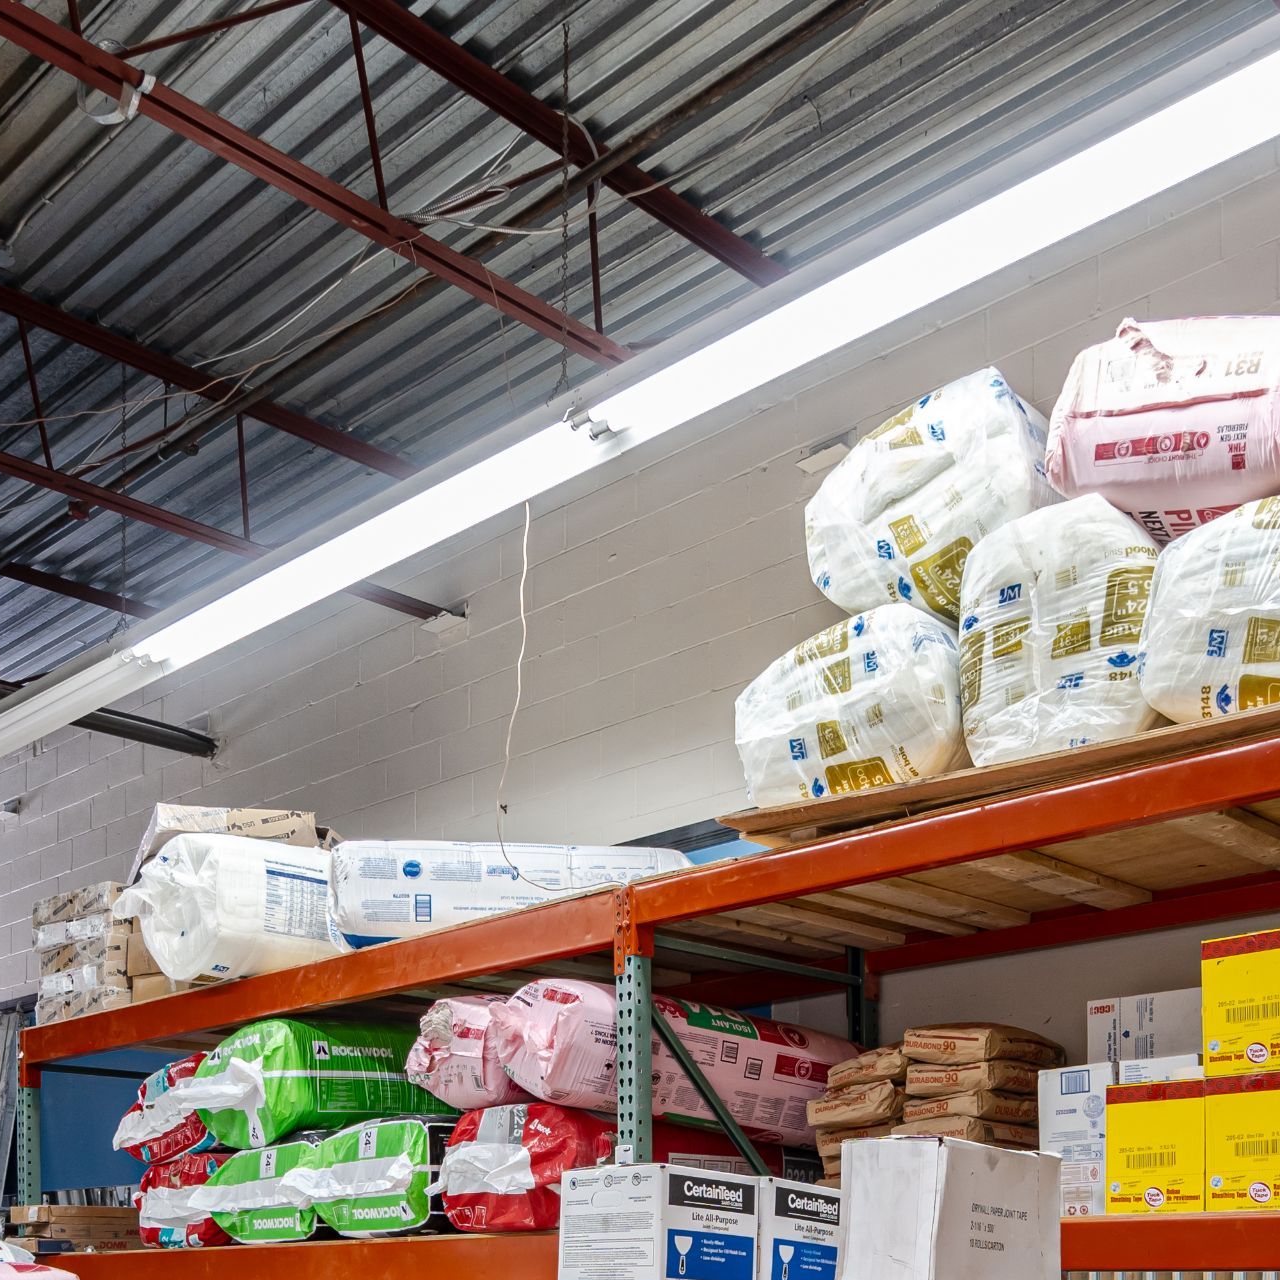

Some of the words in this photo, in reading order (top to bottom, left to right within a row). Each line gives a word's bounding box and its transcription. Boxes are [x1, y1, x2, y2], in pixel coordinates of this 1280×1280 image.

[1225, 354, 1260, 377] R31
[1220, 434, 1232, 443] GEN
[1233, 432, 1247, 441] NEXT
[1201, 685, 1212, 719] 3148
[898, 746, 913, 766] bois
[711, 1018, 752, 1034] ISOLANT
[331, 1045, 394, 1059] ROCKWOOL
[905, 1040, 943, 1051] DURABOND
[943, 1040, 957, 1051] 90
[1209, 1054, 1233, 1063] Sheathing
[1233, 1053, 1245, 1061] Tape
[908, 1076, 944, 1085] DURABOND
[945, 1073, 958, 1084] 90
[904, 1107, 935, 1119] DURABOND
[936, 1101, 949, 1112] 90
[683, 1180, 743, 1203] CertainTeed
[1211, 1191, 1235, 1200] Sheathing
[1236, 1191, 1248, 1199] Tape
[787, 1193, 839, 1216] CertainTeed
[1110, 1196, 1132, 1204] Sheathing
[1132, 1195, 1143, 1203] Tape
[352, 1205, 402, 1221] ROCKWOOL
[691, 1211, 704, 1222] Lite
[704, 1213, 739, 1226] All-Purpose
[971, 1202, 990, 1216] DRYWALL
[990, 1205, 1004, 1217] PAPER
[1003, 1207, 1016, 1220] JOINT
[1016, 1209, 1028, 1222] TAPE
[252, 1217, 295, 1230] ROCKWOOL
[794, 1223, 805, 1233] Lite
[805, 1225, 834, 1238] All-Purpose
